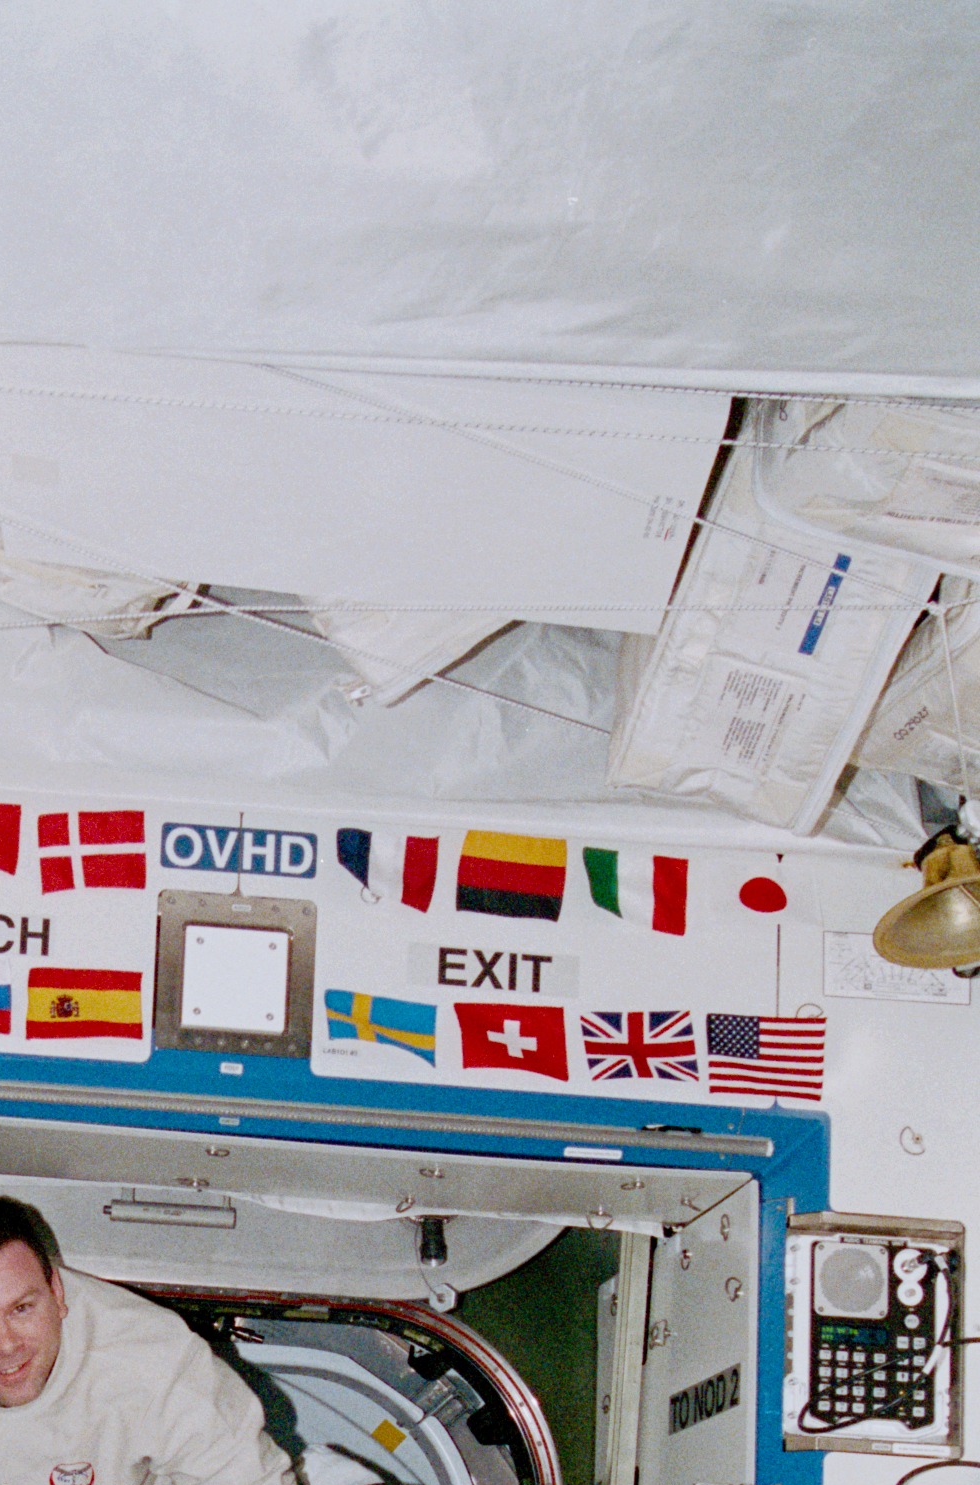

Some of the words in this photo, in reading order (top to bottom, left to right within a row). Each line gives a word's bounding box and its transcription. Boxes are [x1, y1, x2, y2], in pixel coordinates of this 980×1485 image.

[165, 827, 313, 875] OVHD
[437, 948, 553, 992] EXIT
[671, 1391, 689, 1432] TO
[694, 1375, 726, 1423] NOD
[730, 1369, 739, 1406] 2
